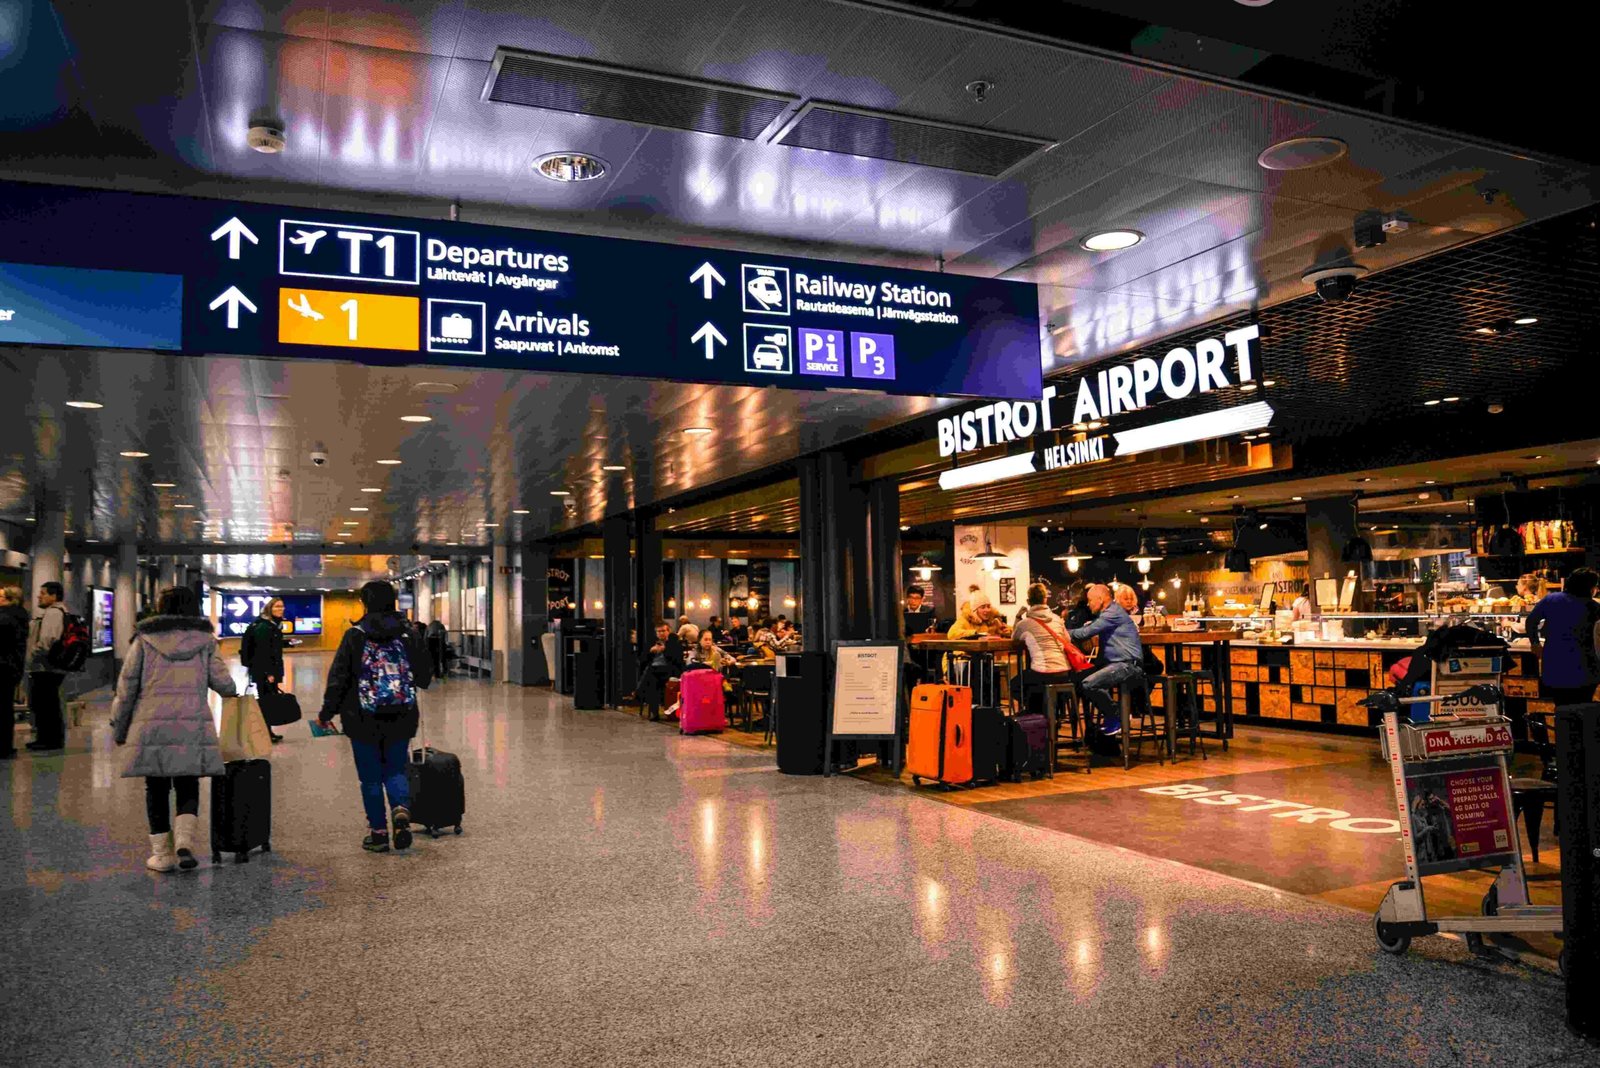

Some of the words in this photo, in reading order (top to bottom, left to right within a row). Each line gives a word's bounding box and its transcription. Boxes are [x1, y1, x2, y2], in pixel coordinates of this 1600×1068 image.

[337, 231, 397, 277] T1
[427, 239, 569, 272] Departures
[427, 267, 486, 284] Lähtevät
[495, 272, 559, 291] Avgångar
[795, 273, 877, 305] Railway
[881, 282, 951, 308] Station
[340, 299, 359, 340] 1
[494, 309, 590, 336] Arrivals
[494, 337, 554, 353] Saapuvat
[563, 342, 620, 357] Ankomst
[806, 362, 839, 372] SERVICE
[938, 386, 1056, 457] BISTROT
[1072, 325, 1260, 425] AIRPORT
[1044, 434, 1104, 471] HELSINKI
[1429, 736, 1451, 748] DNA
[1454, 733, 1493, 746] PREPAID
[1497, 731, 1509, 741] 4G
[1450, 777, 1475, 787] CHOOSE
[1477, 775, 1493, 783] YOUR
[1452, 787, 1467, 795] OWN
[1468, 785, 1481, 793] DNA
[1483, 784, 1494, 792] FOR
[1453, 794, 1478, 804] PREPAID
[1479, 792, 1500, 801] CALLS,
[1464, 802, 1480, 811] DATA
[1481, 801, 1489, 809] OR
[1138, 783, 1402, 841] BISTRO
[1455, 811, 1485, 820] ROAMING
